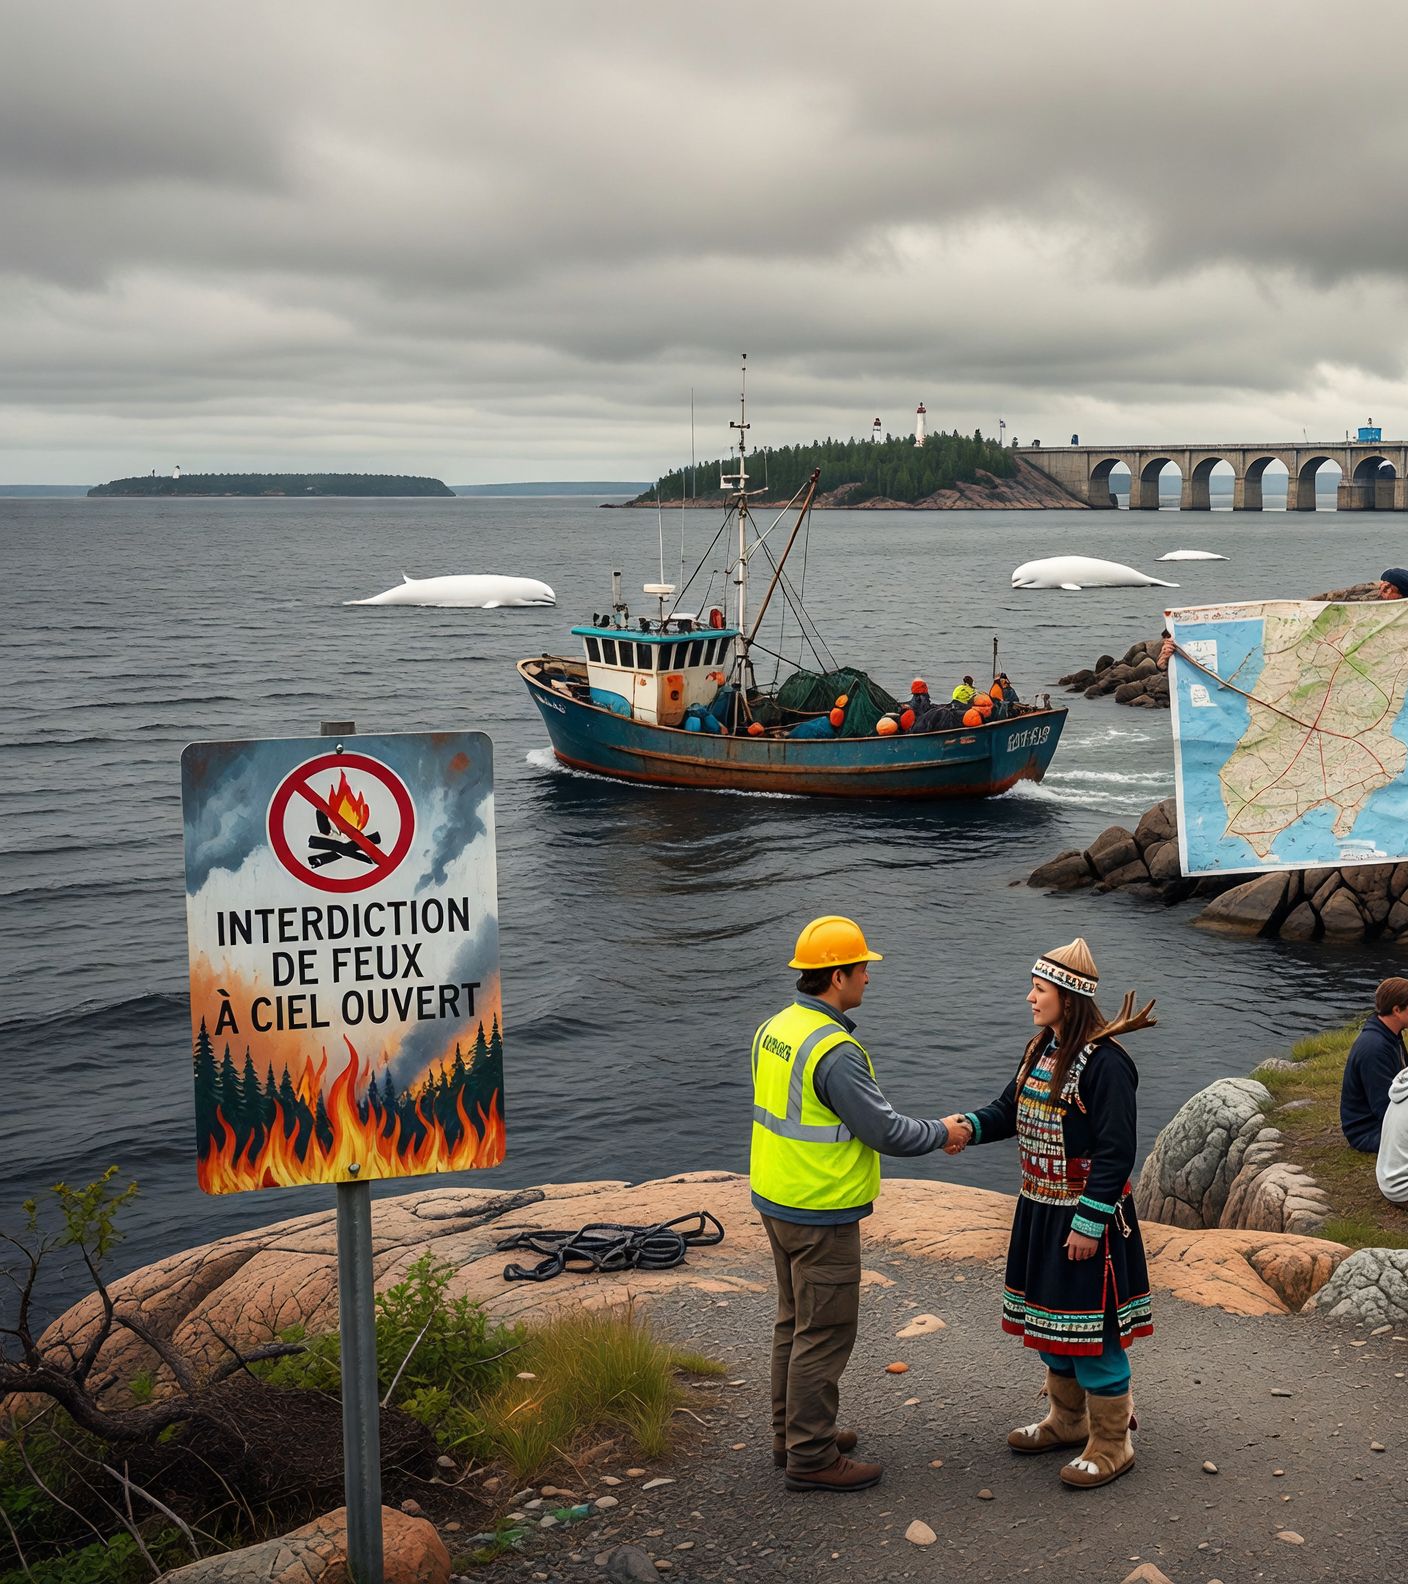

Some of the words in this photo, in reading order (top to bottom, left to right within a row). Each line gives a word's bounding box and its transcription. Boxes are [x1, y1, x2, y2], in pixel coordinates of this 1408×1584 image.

[216, 897, 470, 946] INTERDICTION
[272, 950, 319, 987] DE
[332, 943, 424, 983] FEUX
[214, 989, 239, 1036] À
[251, 993, 330, 1031] CIEL
[341, 982, 481, 1026] OUVERT
